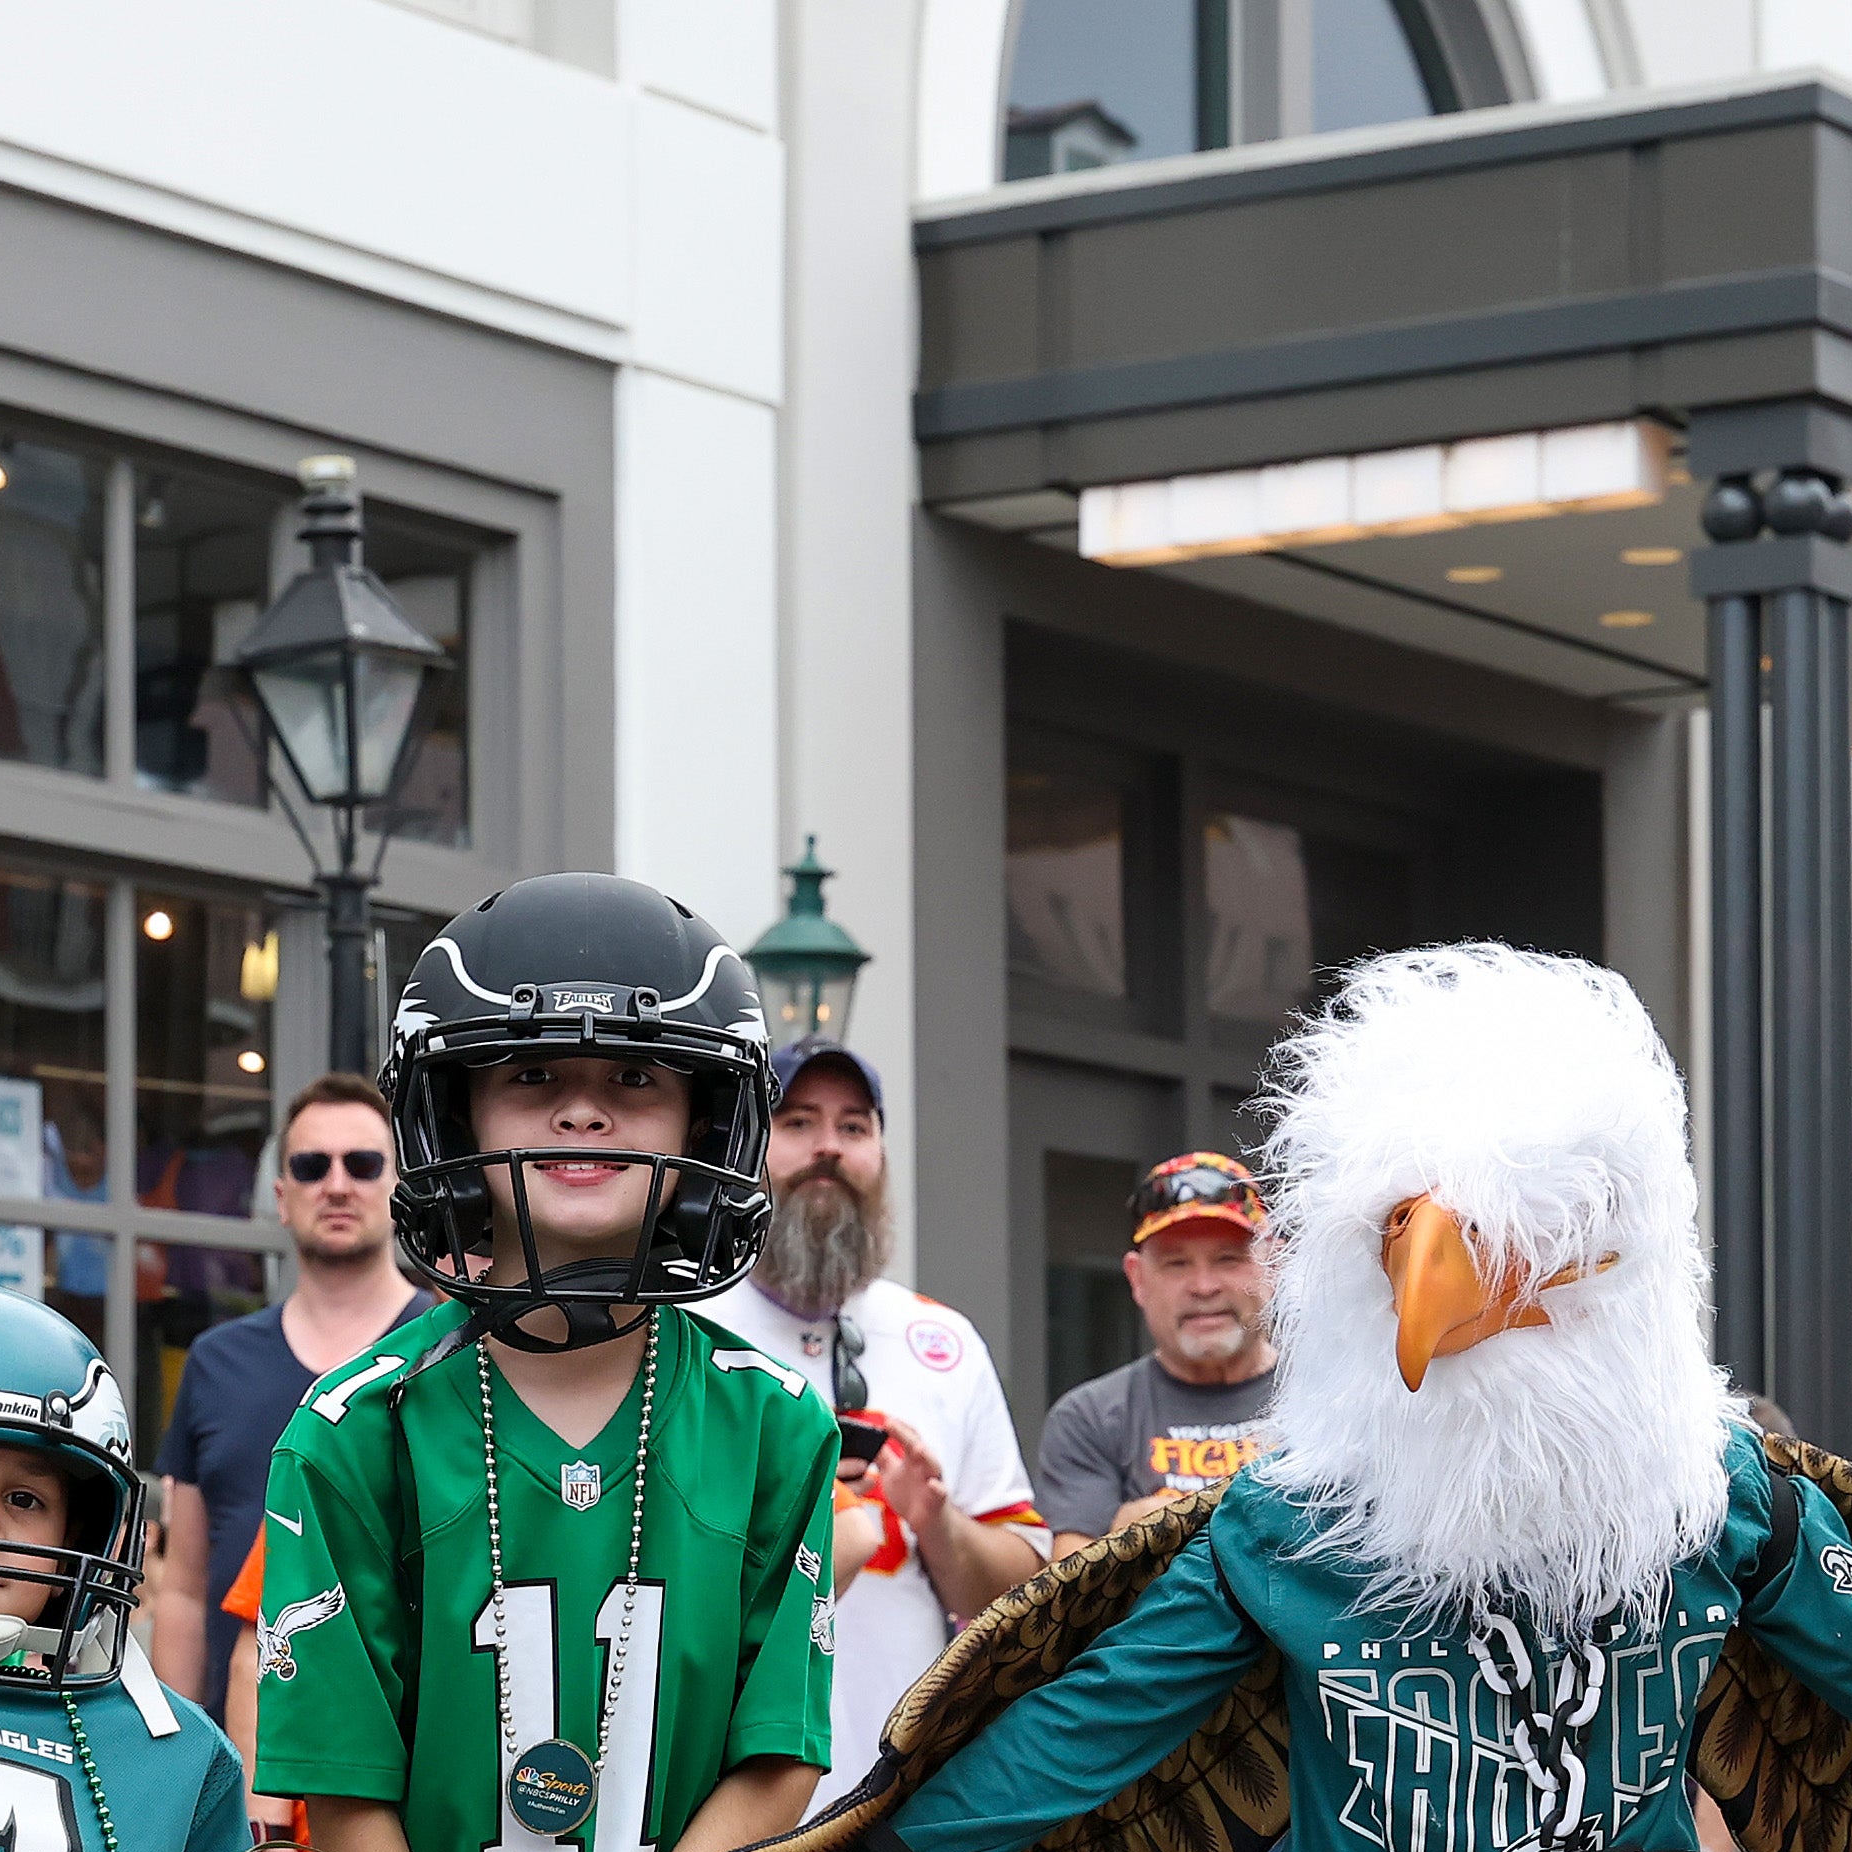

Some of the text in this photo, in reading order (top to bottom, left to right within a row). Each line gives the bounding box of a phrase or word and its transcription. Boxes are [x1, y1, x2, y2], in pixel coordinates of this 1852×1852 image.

[553, 991, 615, 1012] EAGLES
[1149, 1437, 1261, 1478] FIGH
[569, 1483, 596, 1503] NFL
[517, 1784, 580, 1807] @NBCSPHILLY
[539, 1772, 590, 1797] Sports
